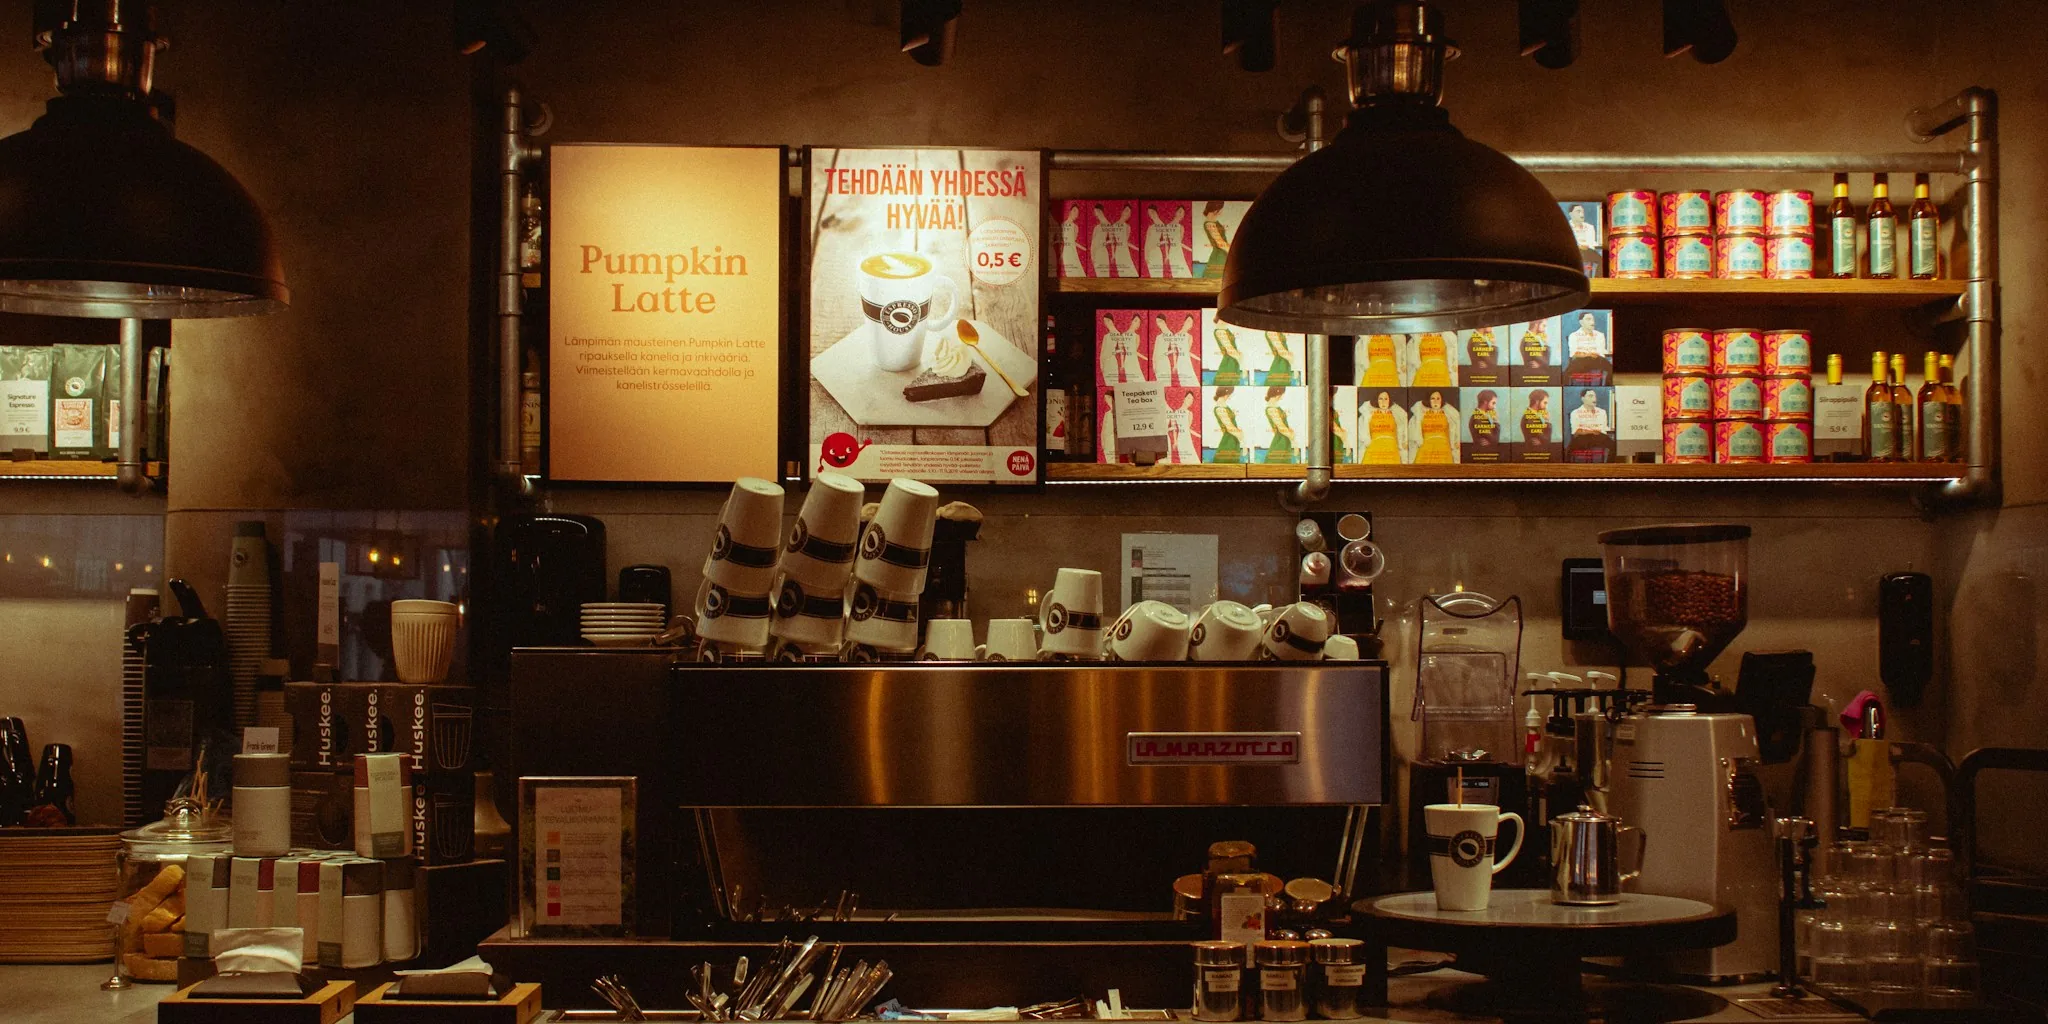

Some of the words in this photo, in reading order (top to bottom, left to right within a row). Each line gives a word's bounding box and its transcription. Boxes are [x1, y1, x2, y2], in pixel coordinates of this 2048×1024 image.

[824, 163, 923, 196] TEHDÄÄN
[930, 165, 1027, 197] YHDESSÄ
[887, 198, 963, 230] HYVÄÄ!
[580, 244, 748, 283] Pumpkin
[977, 252, 1004, 268] 0,5
[1008, 252, 1022, 268] €
[611, 283, 716, 314] Latte
[689, 337, 732, 349] Pumpkin
[736, 338, 766, 348] Latte
[579, 351, 638, 363] ripauksella
[640, 352, 679, 362] kanelia
[682, 353, 692, 364] ja
[575, 365, 650, 376] Viimeistellään
[653, 366, 741, 377] kermavaahdolla
[744, 367, 754, 380] ja
[1122, 389, 1157, 398] Teepaketti
[1012, 454, 1029, 463] NENÄ
[318, 687, 332, 767] Huskee.
[365, 688, 378, 753] uskee.
[411, 688, 425, 770] Huskee.
[261, 743, 275, 751] Green
